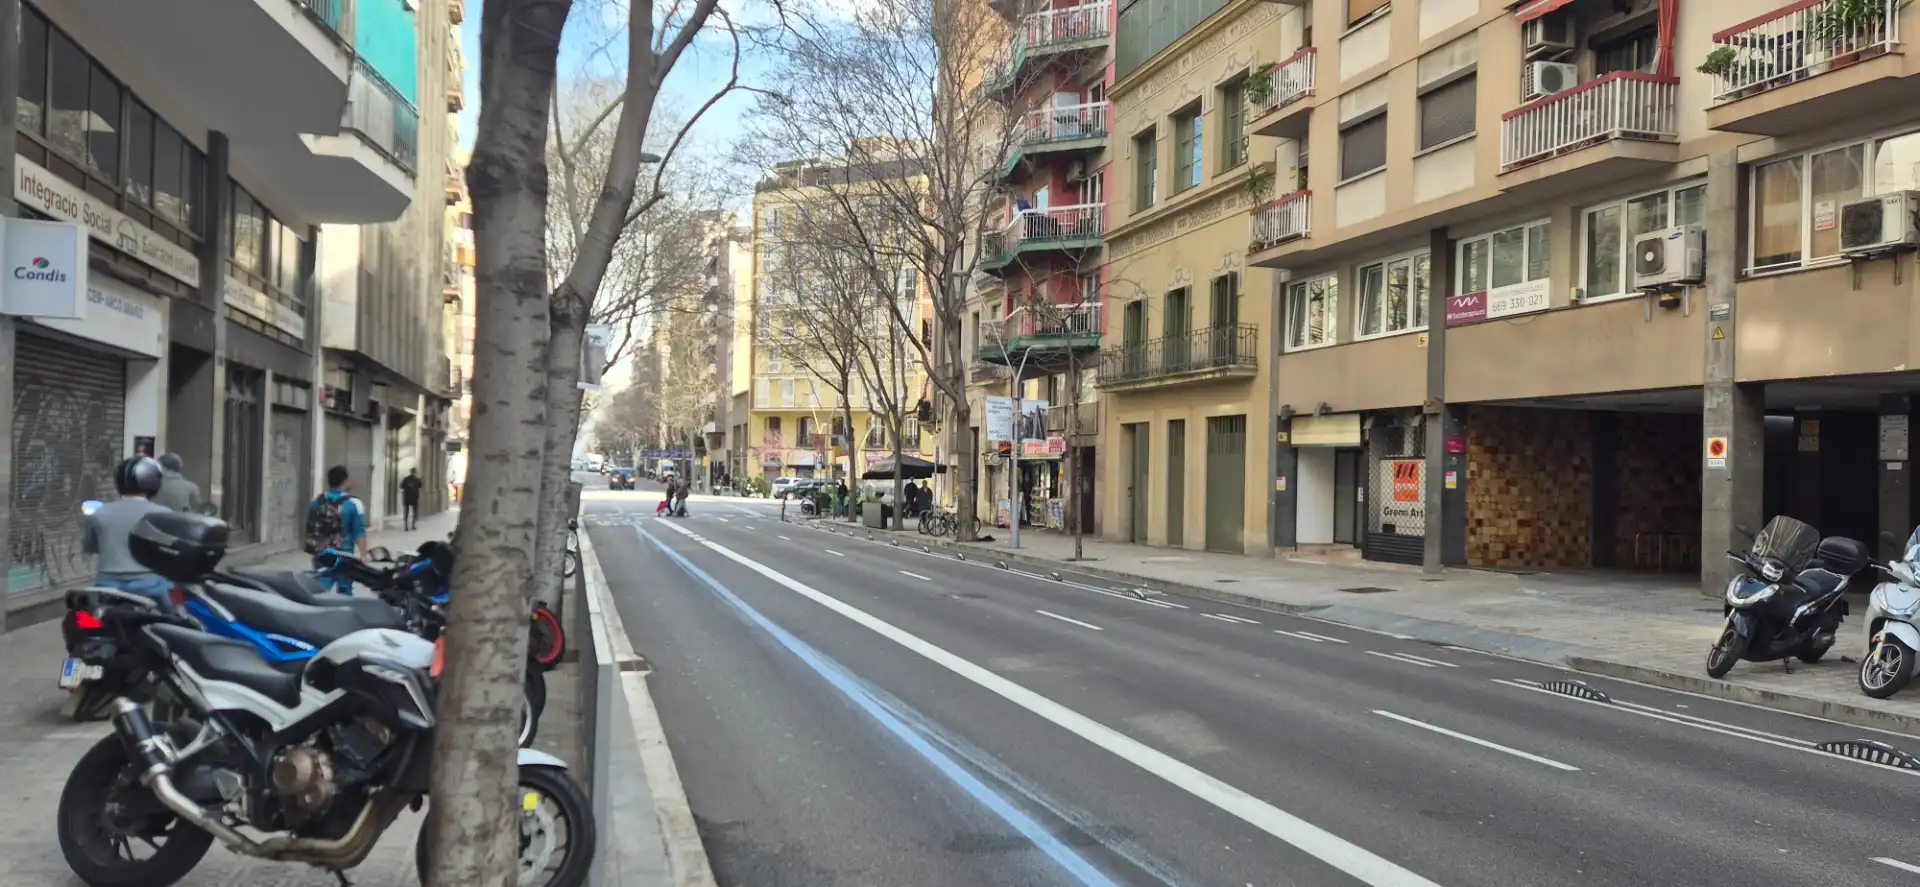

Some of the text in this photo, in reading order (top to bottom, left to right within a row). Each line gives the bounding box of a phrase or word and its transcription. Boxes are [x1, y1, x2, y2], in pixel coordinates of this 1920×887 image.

[20, 167, 111, 235] Integració Social
[14, 266, 67, 282] Condis
[1510, 296, 1525, 309] 330
[1529, 294, 1543, 306] 021
